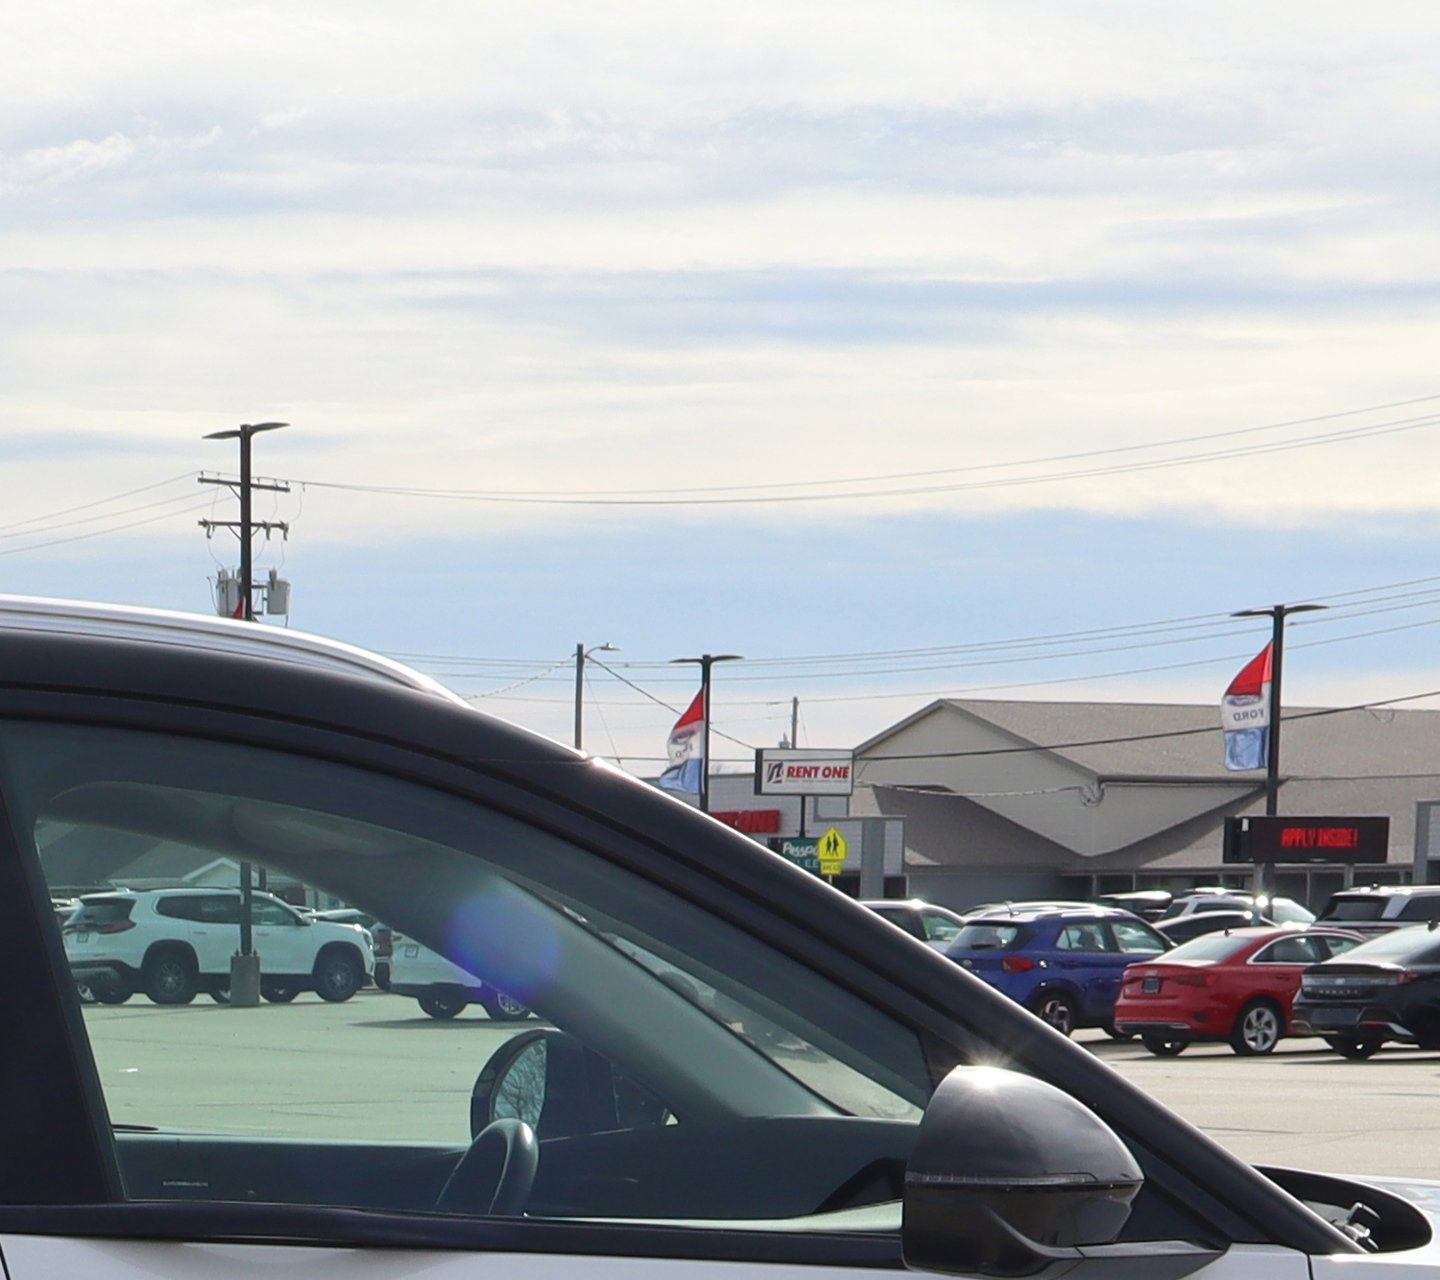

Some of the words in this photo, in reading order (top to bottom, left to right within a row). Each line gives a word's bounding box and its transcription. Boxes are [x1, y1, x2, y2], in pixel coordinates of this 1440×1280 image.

[786, 766, 820, 778] RENT
[822, 766, 849, 778] ONE
[1281, 828, 1316, 847] APPLY
